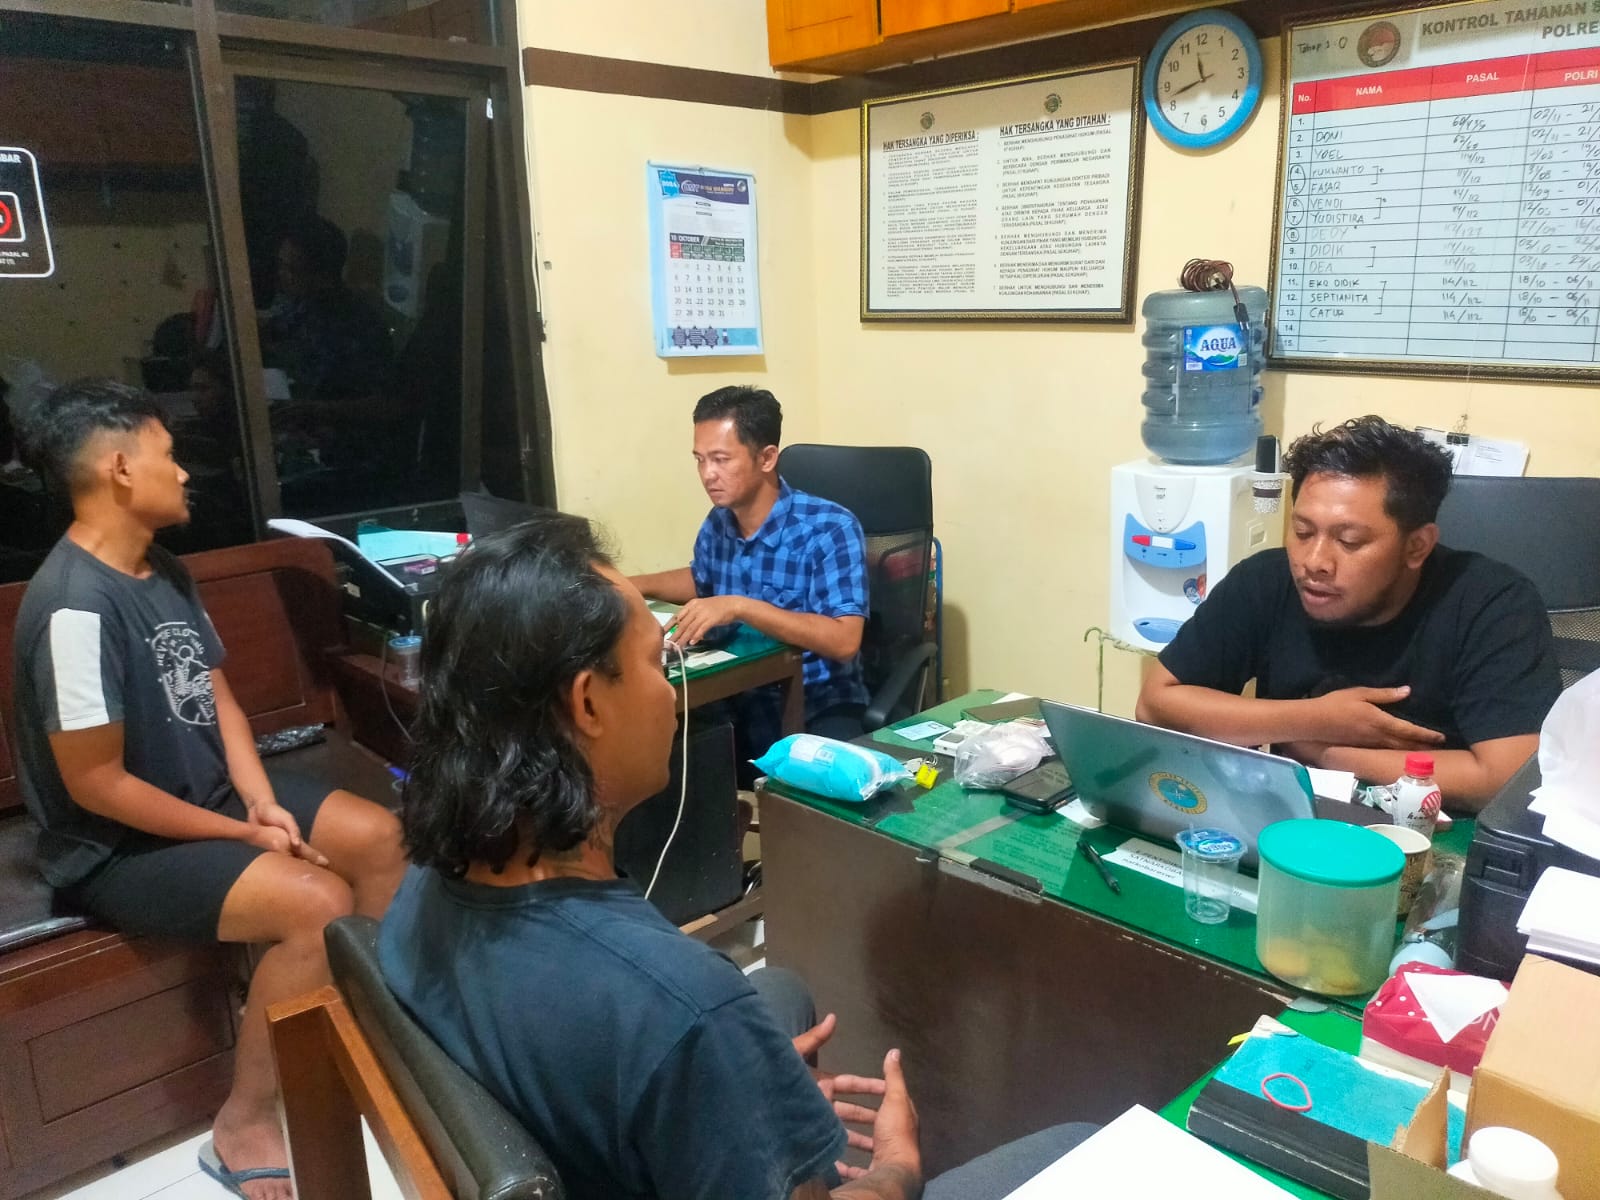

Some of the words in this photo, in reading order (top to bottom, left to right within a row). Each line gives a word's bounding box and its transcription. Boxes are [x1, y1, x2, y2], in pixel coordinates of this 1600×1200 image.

[1422, 13, 1498, 36] KONTROL
[1505, 2, 1586, 24] TAHANAN
[1197, 33, 1207, 46] 12
[1219, 36, 1224, 47] 1
[1180, 43, 1190, 55] 11
[1232, 48, 1239, 60] 2
[1168, 60, 1179, 72] 10
[1238, 67, 1245, 79] 3
[1466, 72, 1499, 83] PASAL
[1564, 70, 1598, 81] POLRI
[1164, 82, 1171, 92] 9
[1356, 86, 1383, 96] NAMA
[1232, 89, 1239, 100] 4
[1298, 94, 1311, 102] No.
[1170, 100, 1176, 111] 8
[1218, 106, 1225, 117] 5
[1184, 112, 1190, 123] 7
[1201, 115, 1207, 126] 6
[1000, 125, 1013, 136] HAK
[1015, 121, 1054, 134] TERSANGKA
[1056, 118, 1074, 130] YANG
[1076, 113, 1106, 126] DITAHAN
[883, 141, 895, 150] HAK
[896, 136, 927, 149] TERSANGKA
[929, 134, 944, 144] YANG
[946, 130, 976, 143] DIPERIKSA
[1310, 292, 1368, 303] SEPTIANITA
[1309, 307, 1344, 318] CATUR
[1200, 337, 1236, 352] AQUA
